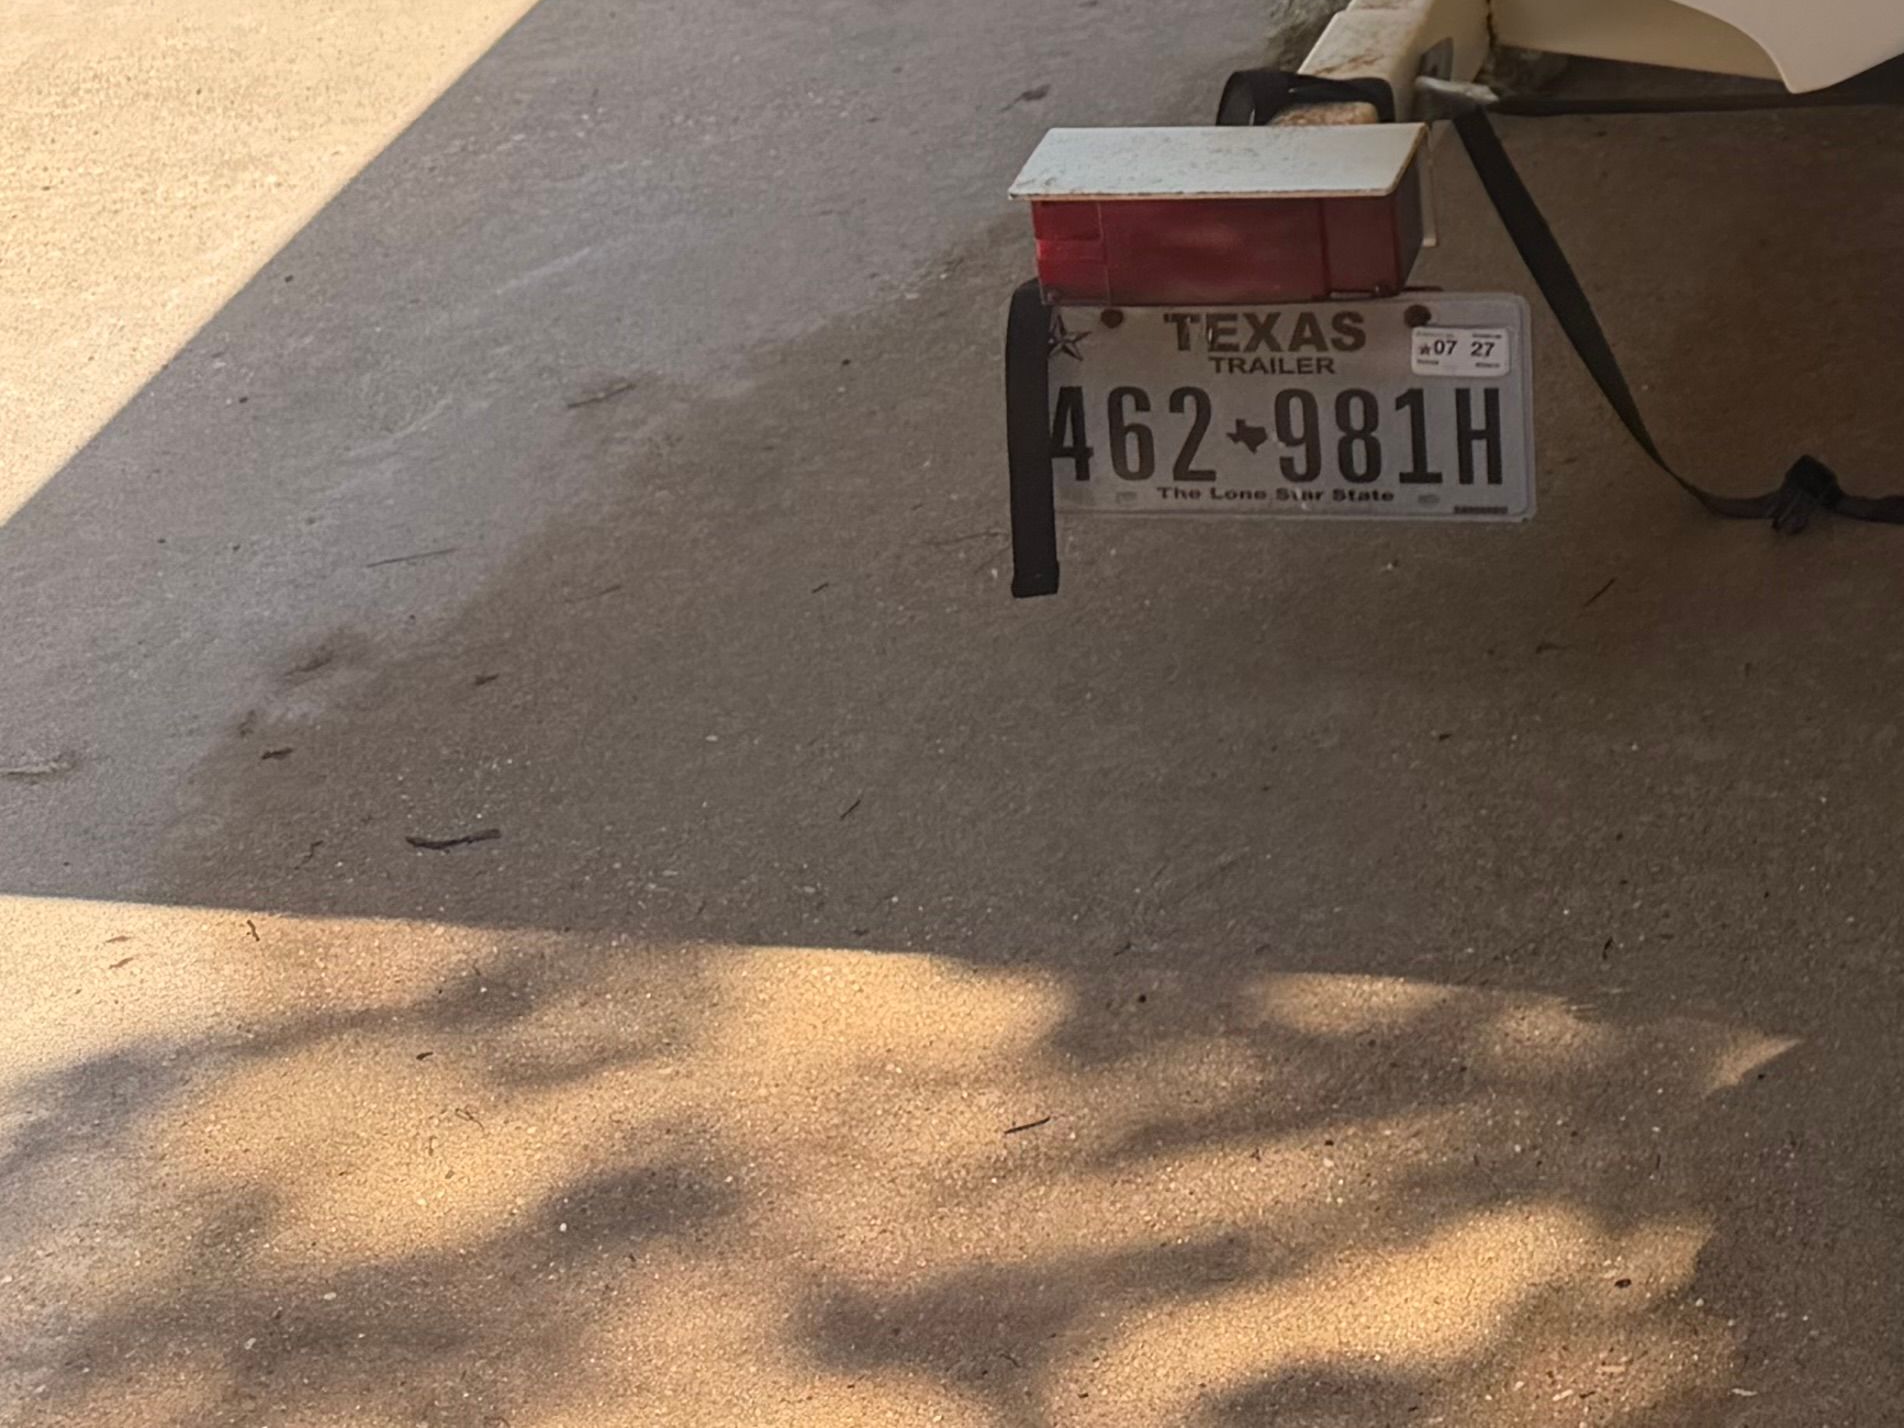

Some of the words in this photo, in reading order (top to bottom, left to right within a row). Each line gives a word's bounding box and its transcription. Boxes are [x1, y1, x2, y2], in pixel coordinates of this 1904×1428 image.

[1163, 311, 1366, 352] TEXAS
[1434, 338, 1457, 355] 07
[1471, 340, 1495, 357] 27
[1209, 356, 1336, 375] TRAILER
[1051, 386, 1217, 482] 462
[1274, 388, 1503, 485] 981H
[1157, 487, 1202, 500] The
[1210, 487, 1267, 501] Lone
[1275, 487, 1324, 502] Star
[1332, 488, 1395, 502] State
